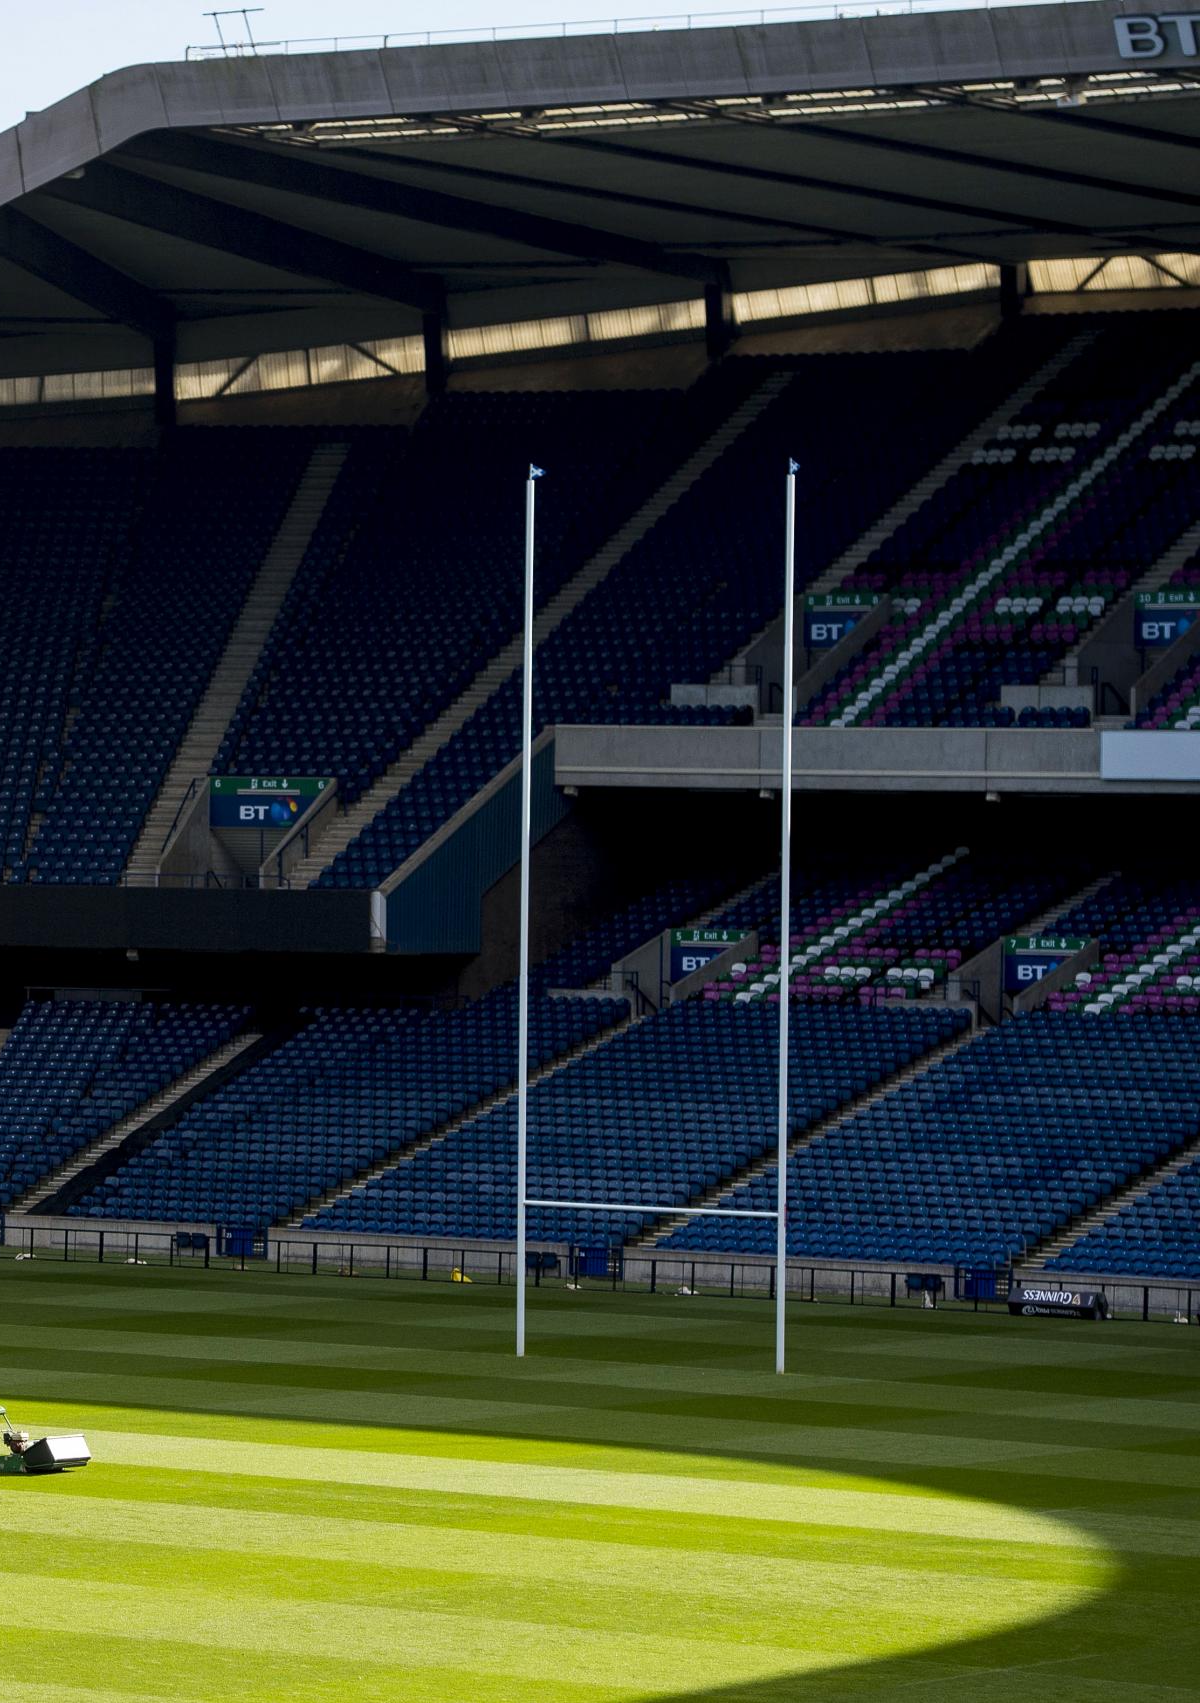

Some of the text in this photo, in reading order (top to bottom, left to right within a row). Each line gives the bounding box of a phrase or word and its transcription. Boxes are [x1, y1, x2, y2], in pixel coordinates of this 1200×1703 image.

[1113, 15, 1200, 59] BT
[1140, 594, 1184, 603] 10 Exit
[811, 624, 843, 640] BT
[1141, 622, 1176, 640] BT
[215, 780, 324, 789] 6 Exit 6
[239, 805, 269, 820] BT
[676, 932, 682, 940] 5
[704, 932, 717, 940] Exit
[1010, 939, 1086, 950] 7 Exit 7
[682, 956, 710, 971] BT
[1017, 965, 1047, 980] BT
[1022, 1289, 1072, 1305] GUINNESS
